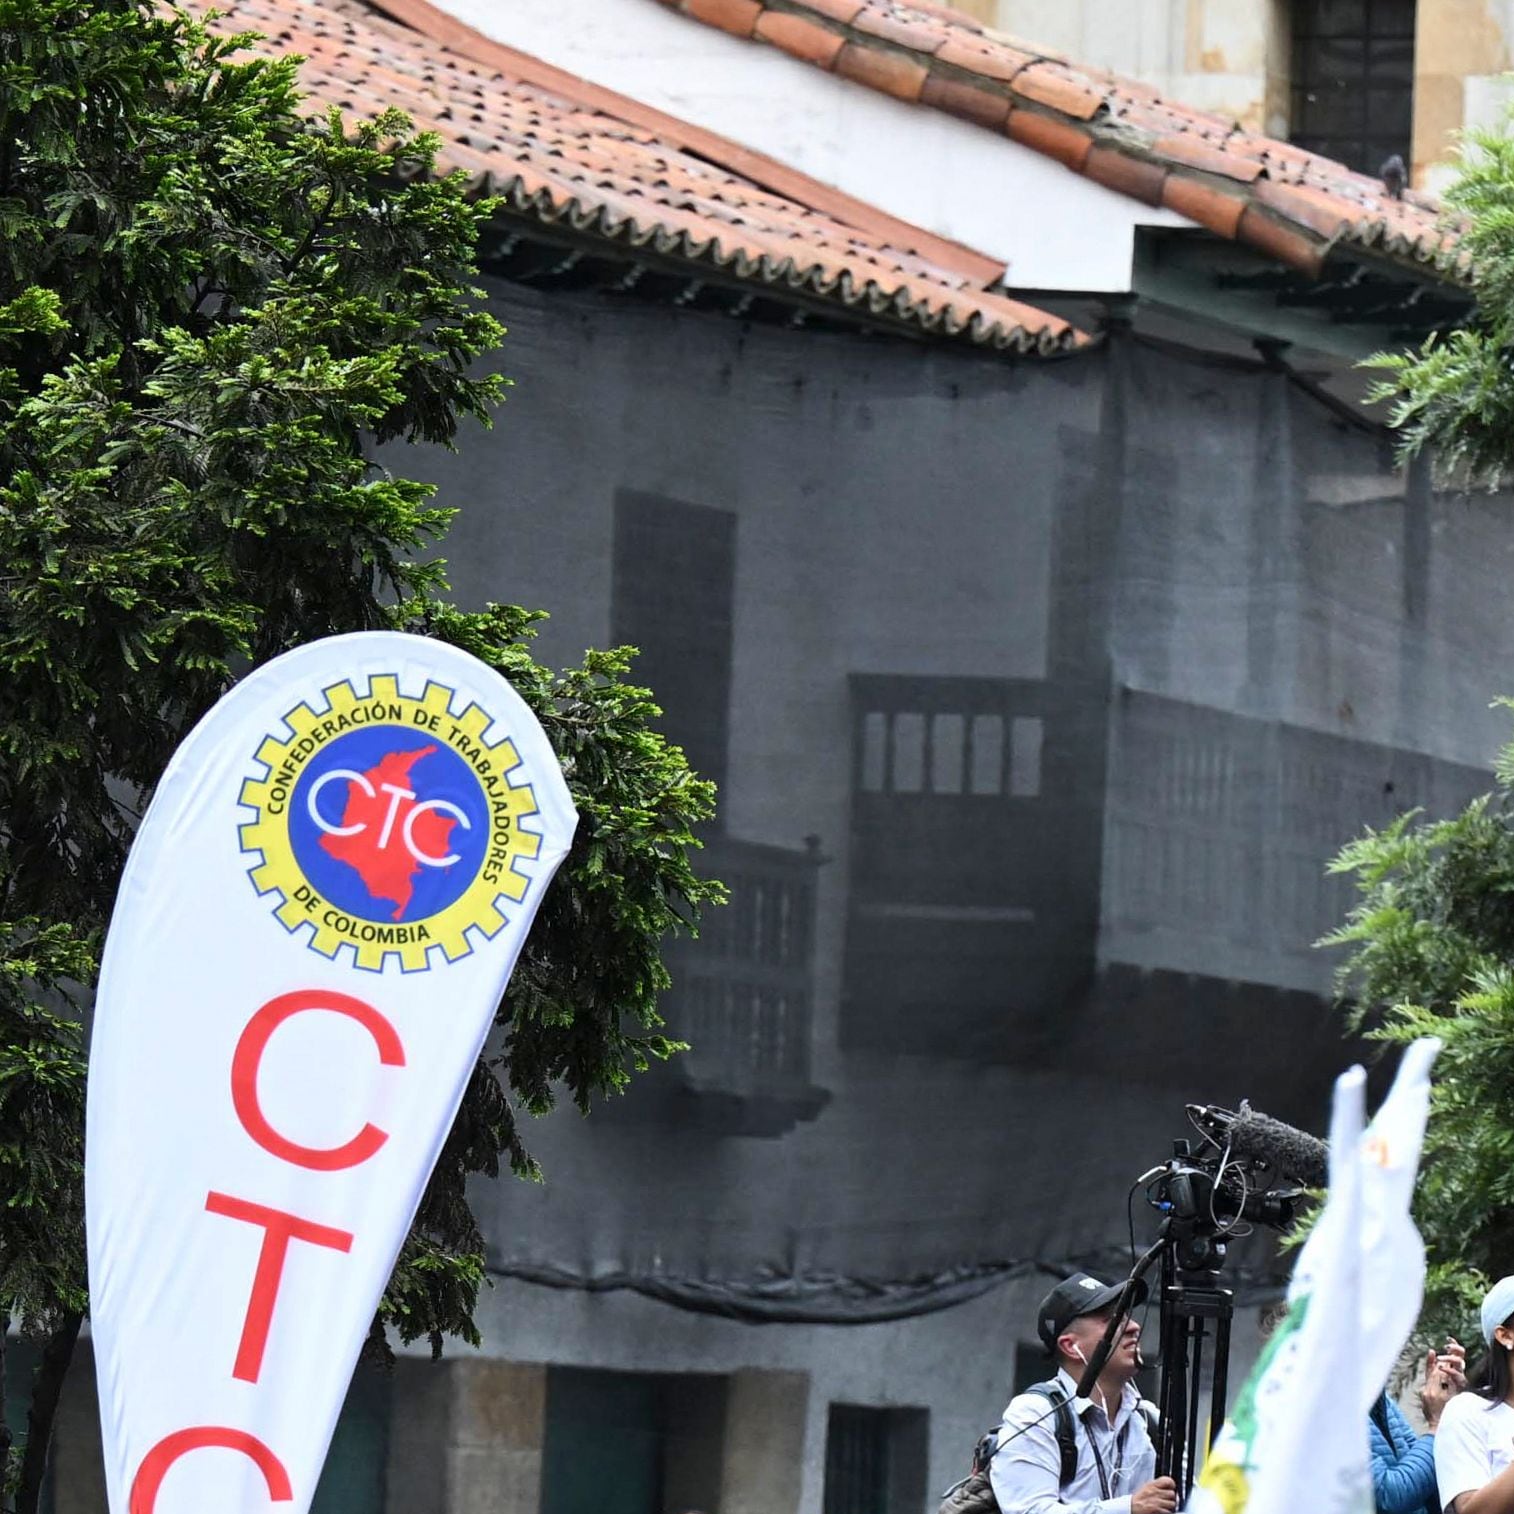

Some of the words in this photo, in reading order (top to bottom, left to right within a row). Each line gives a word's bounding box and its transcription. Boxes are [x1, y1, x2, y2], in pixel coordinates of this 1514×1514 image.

[268, 701, 402, 815] CONFEDERACIÓN
[413, 709, 441, 732] DE
[448, 725, 511, 885] TRABAJADORES
[307, 769, 471, 867] CTC
[292, 885, 321, 913] DE
[323, 911, 430, 945] COLOMBIA
